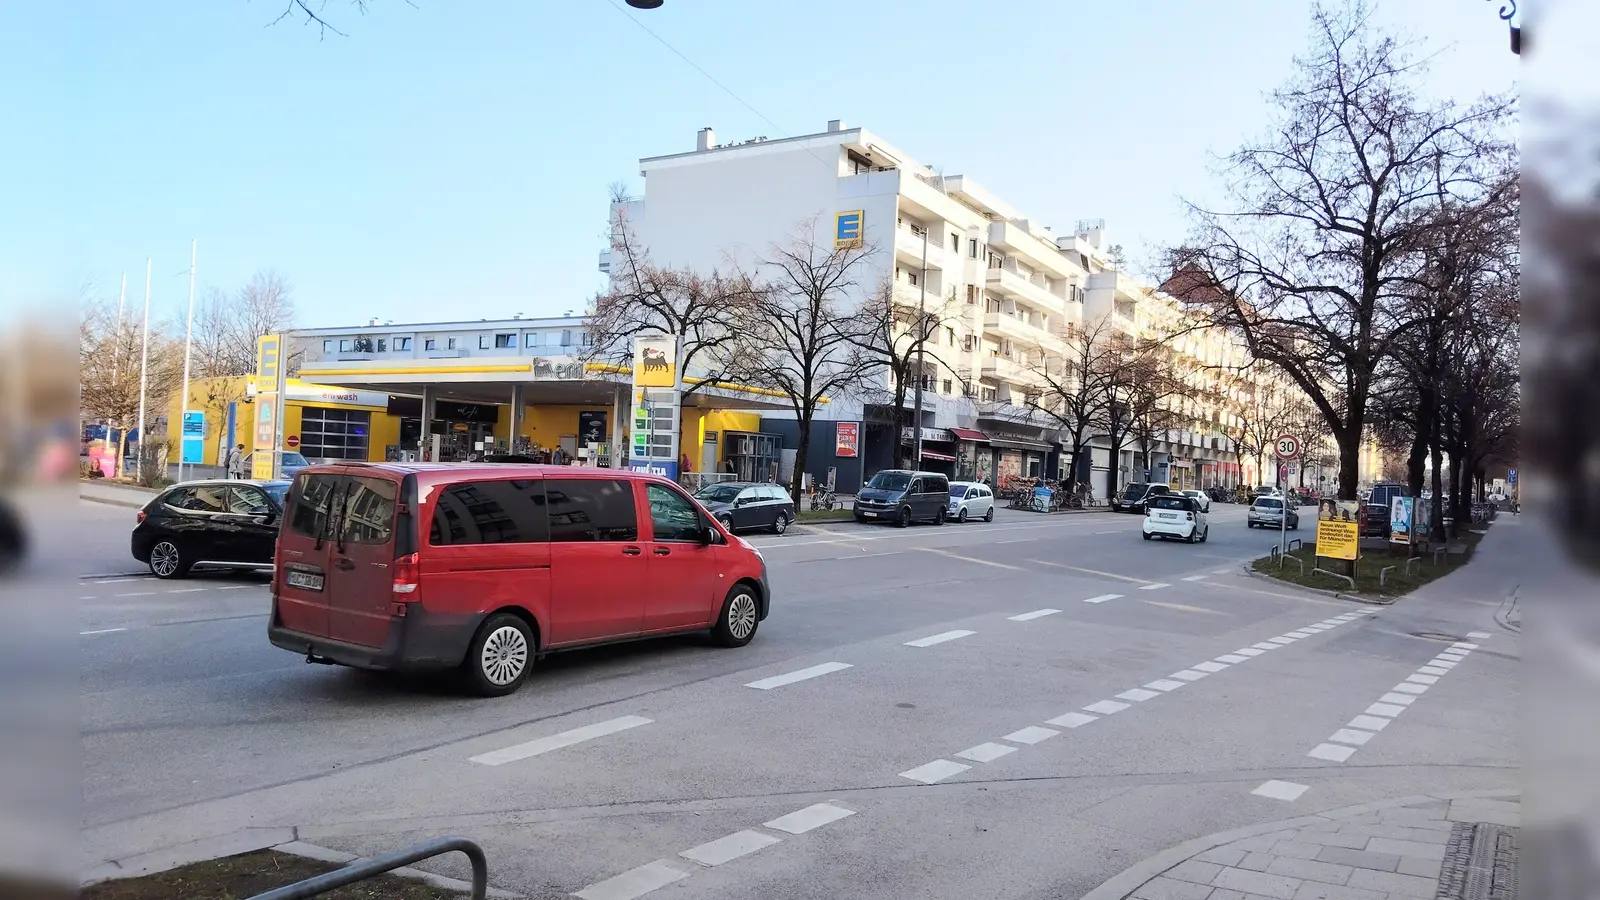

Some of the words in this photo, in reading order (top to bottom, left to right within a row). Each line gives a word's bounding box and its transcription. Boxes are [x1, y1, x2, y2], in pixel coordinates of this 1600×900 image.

[838, 214, 859, 240] E
[260, 340, 277, 376] E
[336, 392, 358, 401] wash
[1279, 441, 1294, 452] 30
